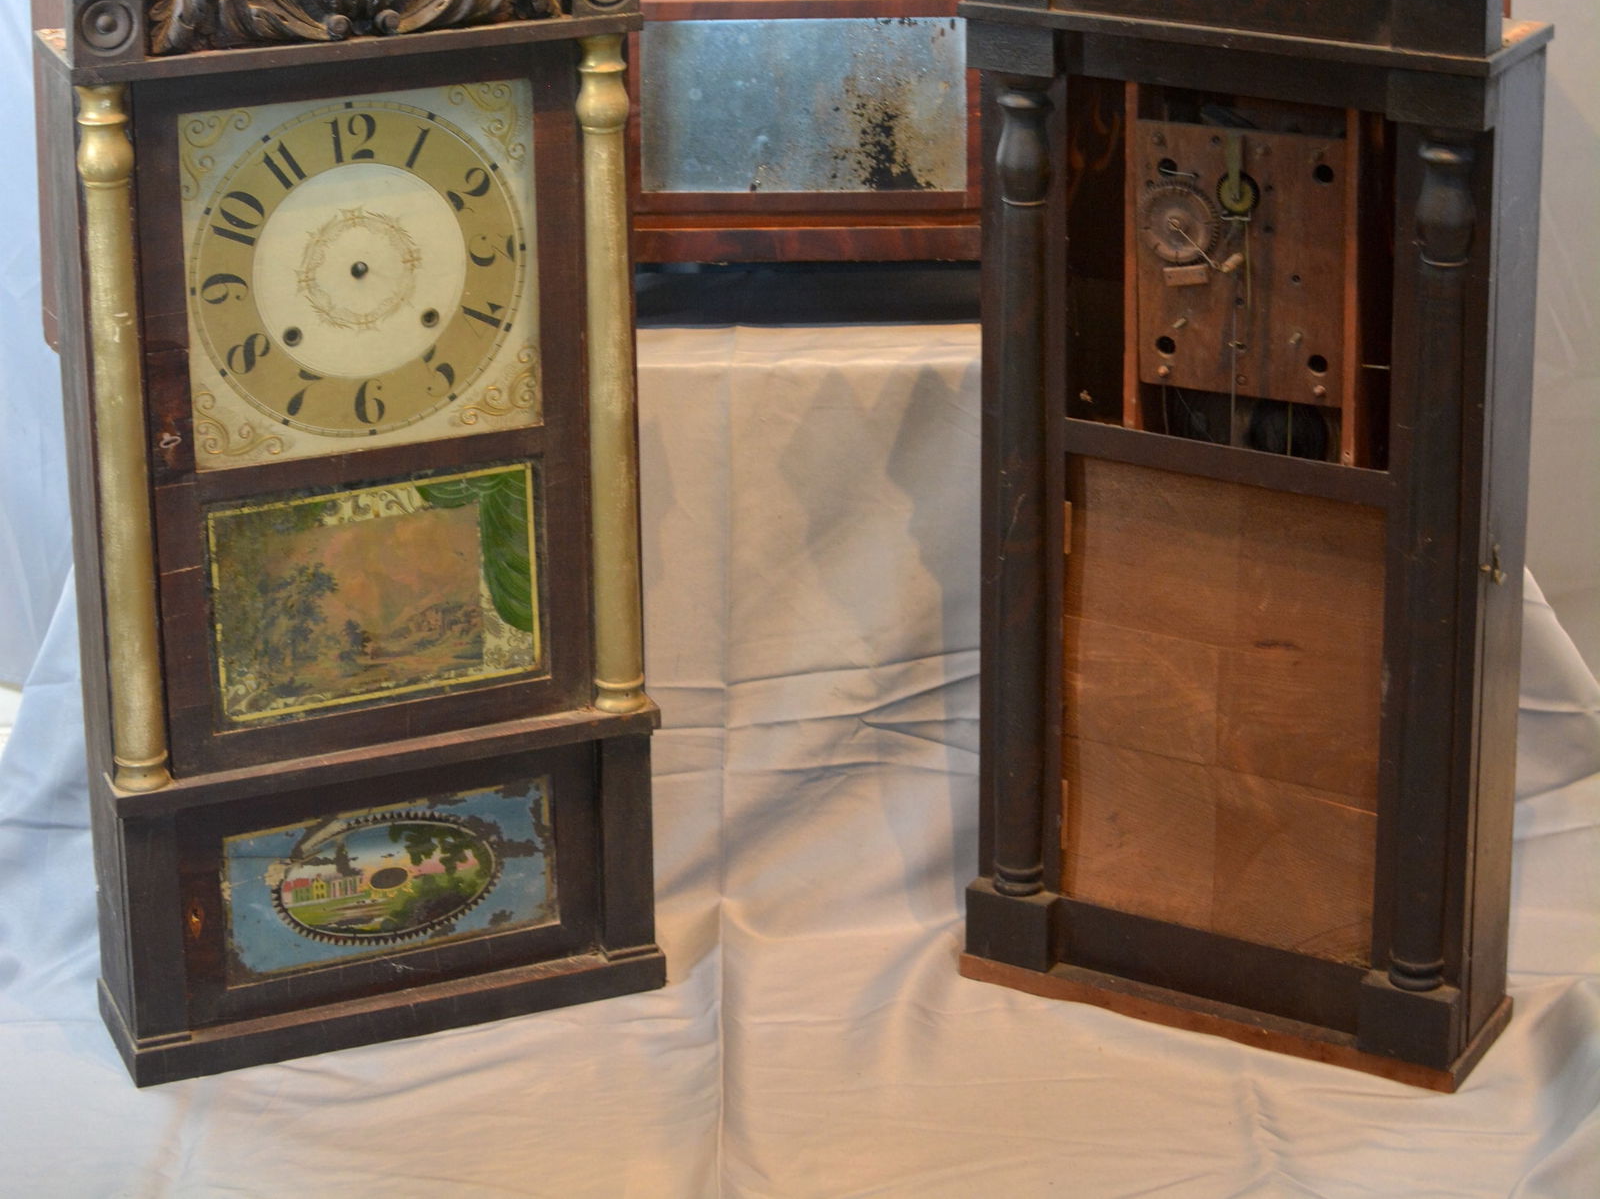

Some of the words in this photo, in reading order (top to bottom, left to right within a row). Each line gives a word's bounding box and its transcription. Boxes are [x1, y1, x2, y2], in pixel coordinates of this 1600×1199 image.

[324, 113, 377, 164] 12
[404, 125, 431, 169] 1
[262, 139, 307, 190] 11
[446, 166, 492, 214] 2
[210, 190, 265, 247] 10
[467, 233, 516, 268] 3
[200, 272, 249, 305] 9
[460, 300, 506, 339] 4
[226, 332, 272, 375] 8
[422, 343, 456, 399] 5
[286, 367, 324, 417] 7
[354, 377, 386, 424] 6
